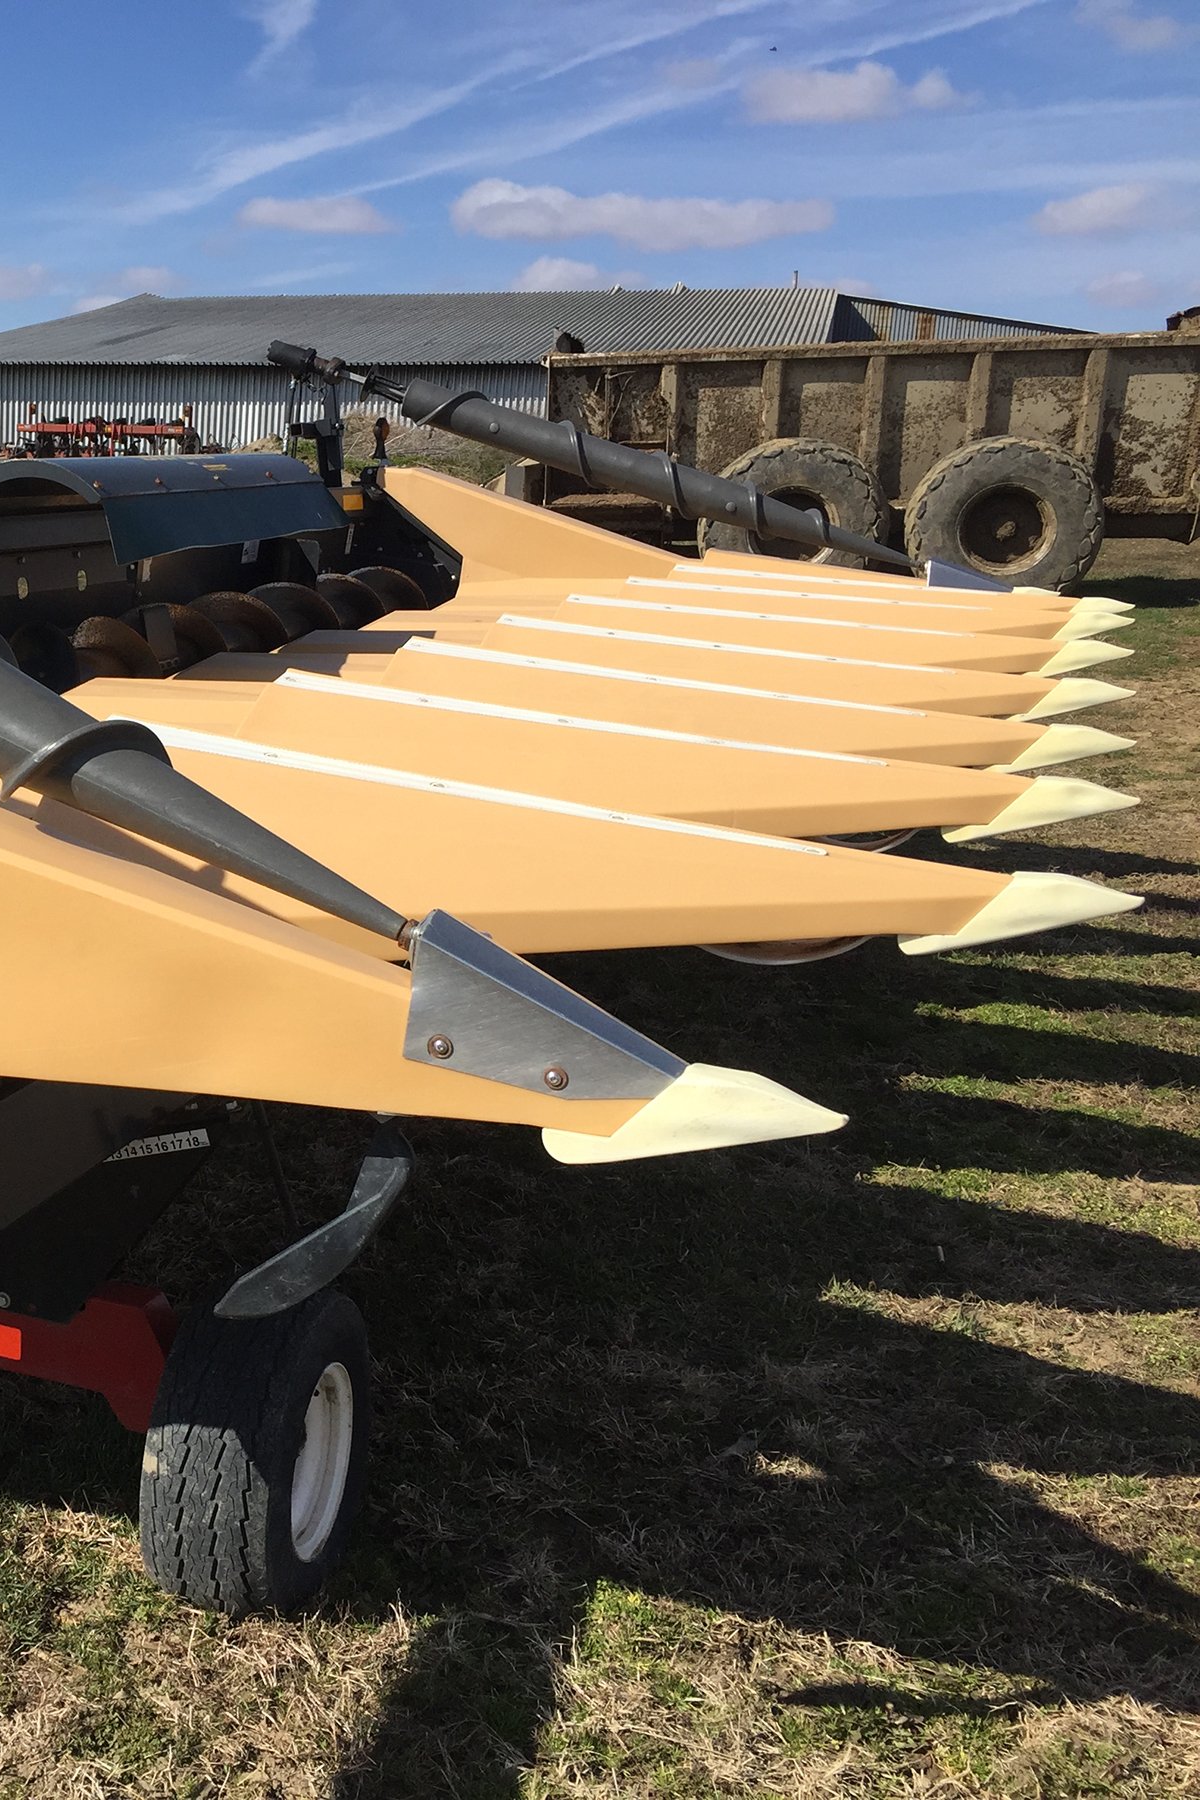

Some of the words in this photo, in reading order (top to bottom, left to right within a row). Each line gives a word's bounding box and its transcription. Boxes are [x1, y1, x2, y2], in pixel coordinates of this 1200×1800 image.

[124, 1146, 138, 1157] 14
[140, 1144, 153, 1155] 15
[154, 1141, 169, 1152] 16
[170, 1138, 184, 1150] 17
[185, 1136, 200, 1147] 18
